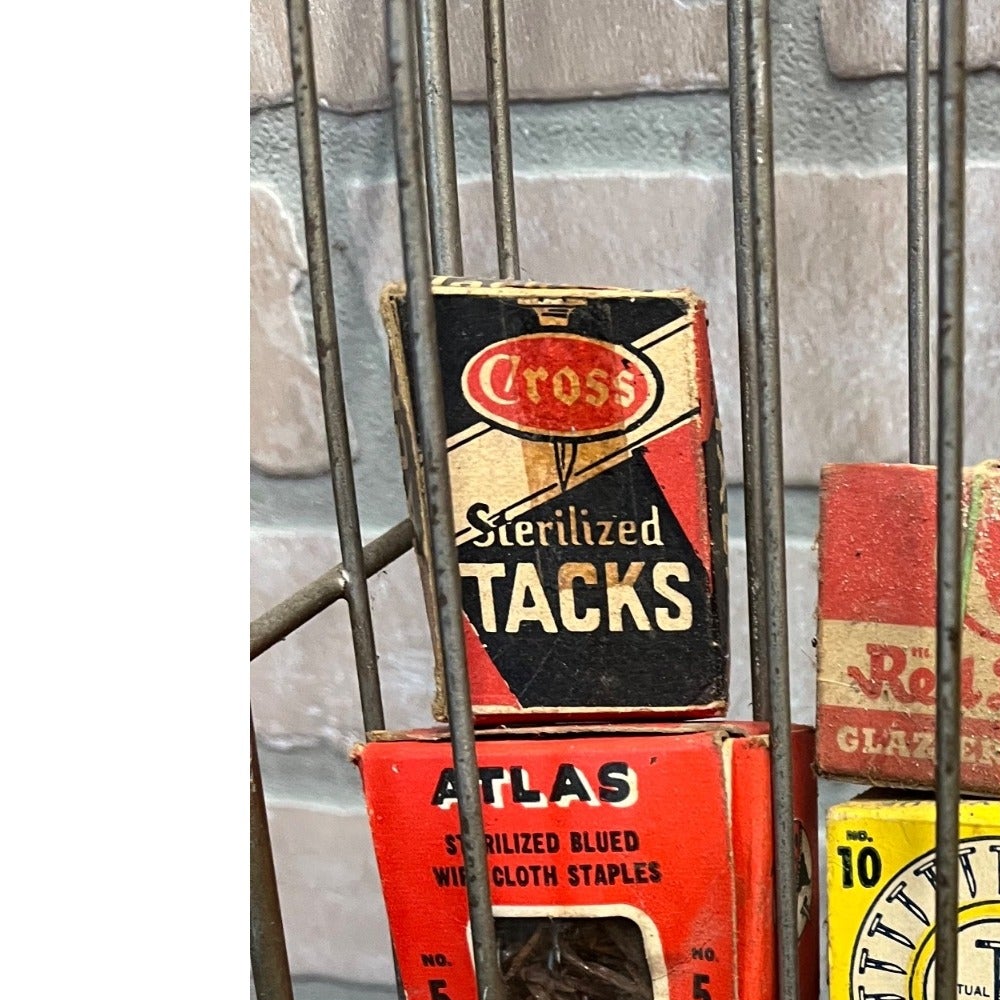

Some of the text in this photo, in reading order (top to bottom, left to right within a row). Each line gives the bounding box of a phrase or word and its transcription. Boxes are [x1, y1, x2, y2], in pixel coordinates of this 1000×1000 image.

[478, 354, 637, 408] Cross
[466, 502, 664, 548] Sterilized
[459, 561, 694, 634] TACKS
[431, 762, 638, 809] ATLAS
[445, 830, 641, 857] STRILIZED BLUED
[492, 864, 558, 888] CLOTH
[567, 860, 663, 887] STAPLES
[837, 845, 883, 889] 10
[421, 953, 452, 968] NO.
[957, 984, 991, 999] TUAL
